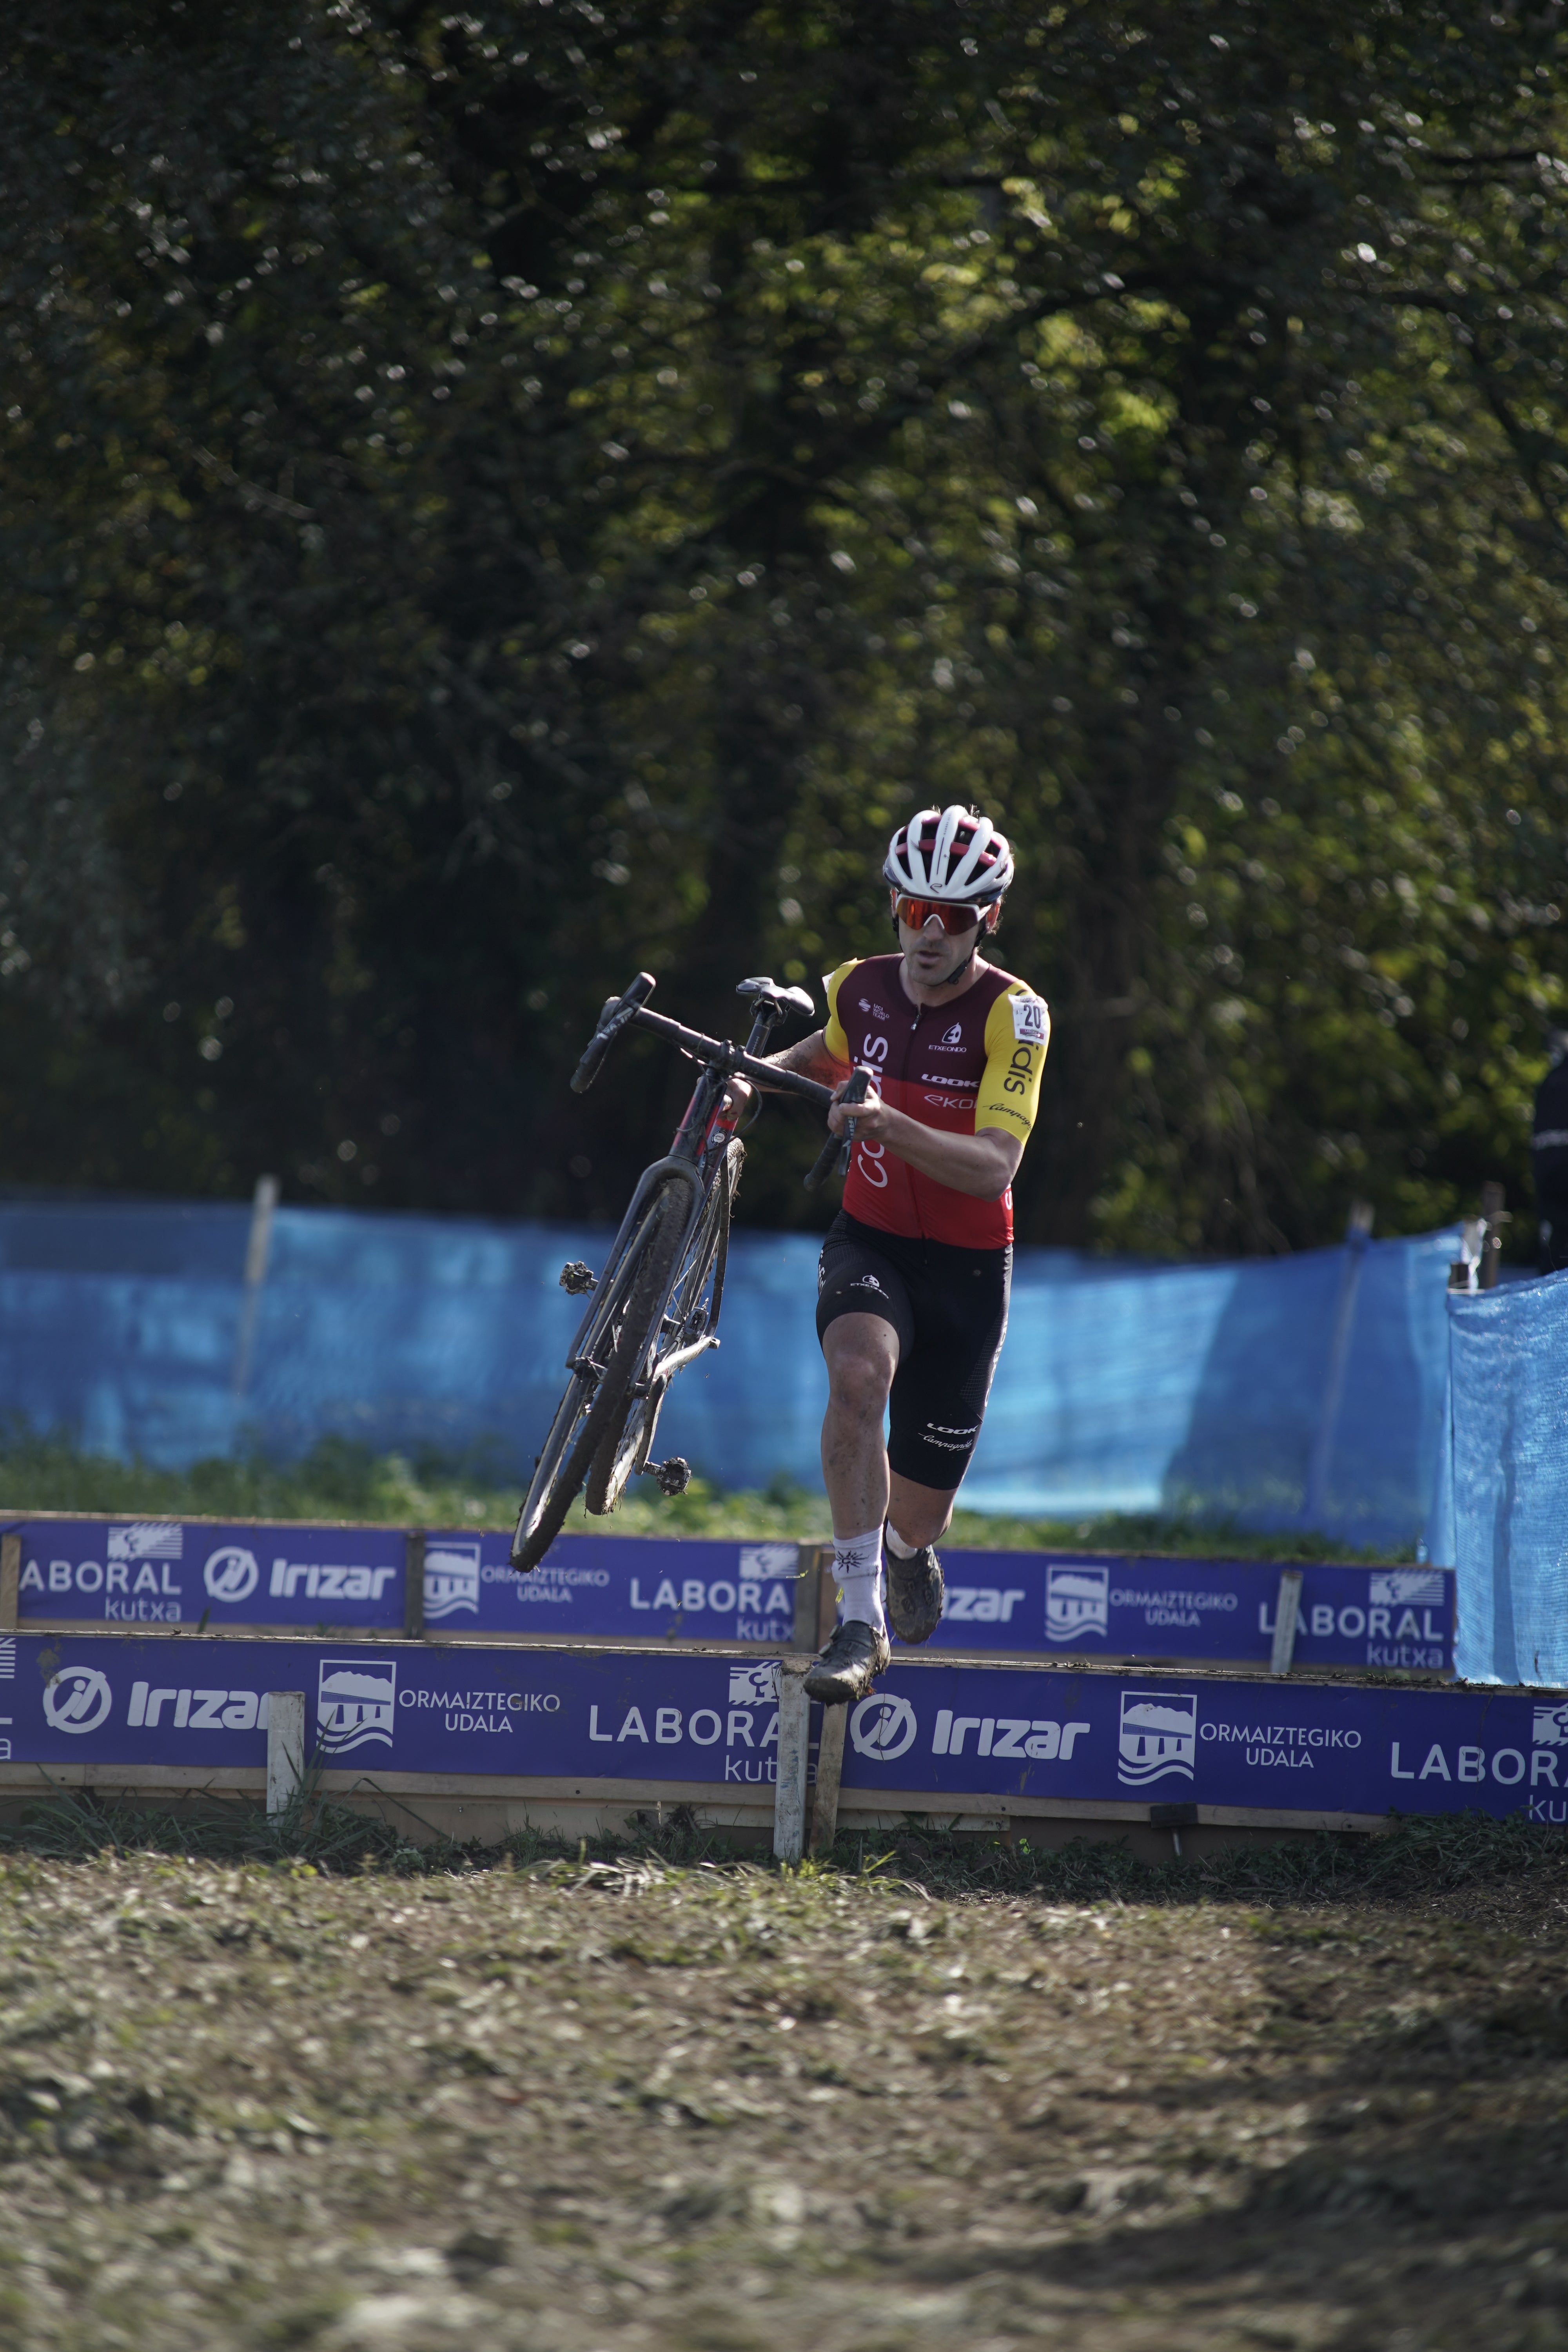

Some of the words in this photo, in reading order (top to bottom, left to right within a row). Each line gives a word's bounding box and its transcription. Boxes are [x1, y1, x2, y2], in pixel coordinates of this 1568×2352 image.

[873, 1007, 890, 1018] WORLD
[873, 1011, 885, 1020] TEAM
[1024, 1004, 1041, 1029] 20
[921, 1074, 980, 1087] LOOK
[927, 1423, 979, 1434] LOOK
[20, 1560, 181, 1594] ABORAL
[270, 1559, 396, 1599] Irizar
[481, 1565, 610, 1588] ORMAIZTEGIKO
[517, 1585, 572, 1603] UDALA
[630, 1578, 791, 1614] LABORA
[1109, 1588, 1238, 1611] ORMAIZTEGIKO
[105, 1597, 181, 1622] kutxa
[1145, 1610, 1200, 1627] UDALA
[737, 1617, 795, 1641] kutx
[1367, 1642, 1443, 1670] kutxa
[399, 1690, 560, 1712] ORMAIZTEGIKO
[445, 1713, 513, 1733] UDALA
[931, 1710, 1091, 1760] Irizar
[1200, 1723, 1361, 1748] ORMAIZTEGIKO
[1246, 1748, 1314, 1768] UDALA
[1391, 1742, 1568, 1788] LABOR
